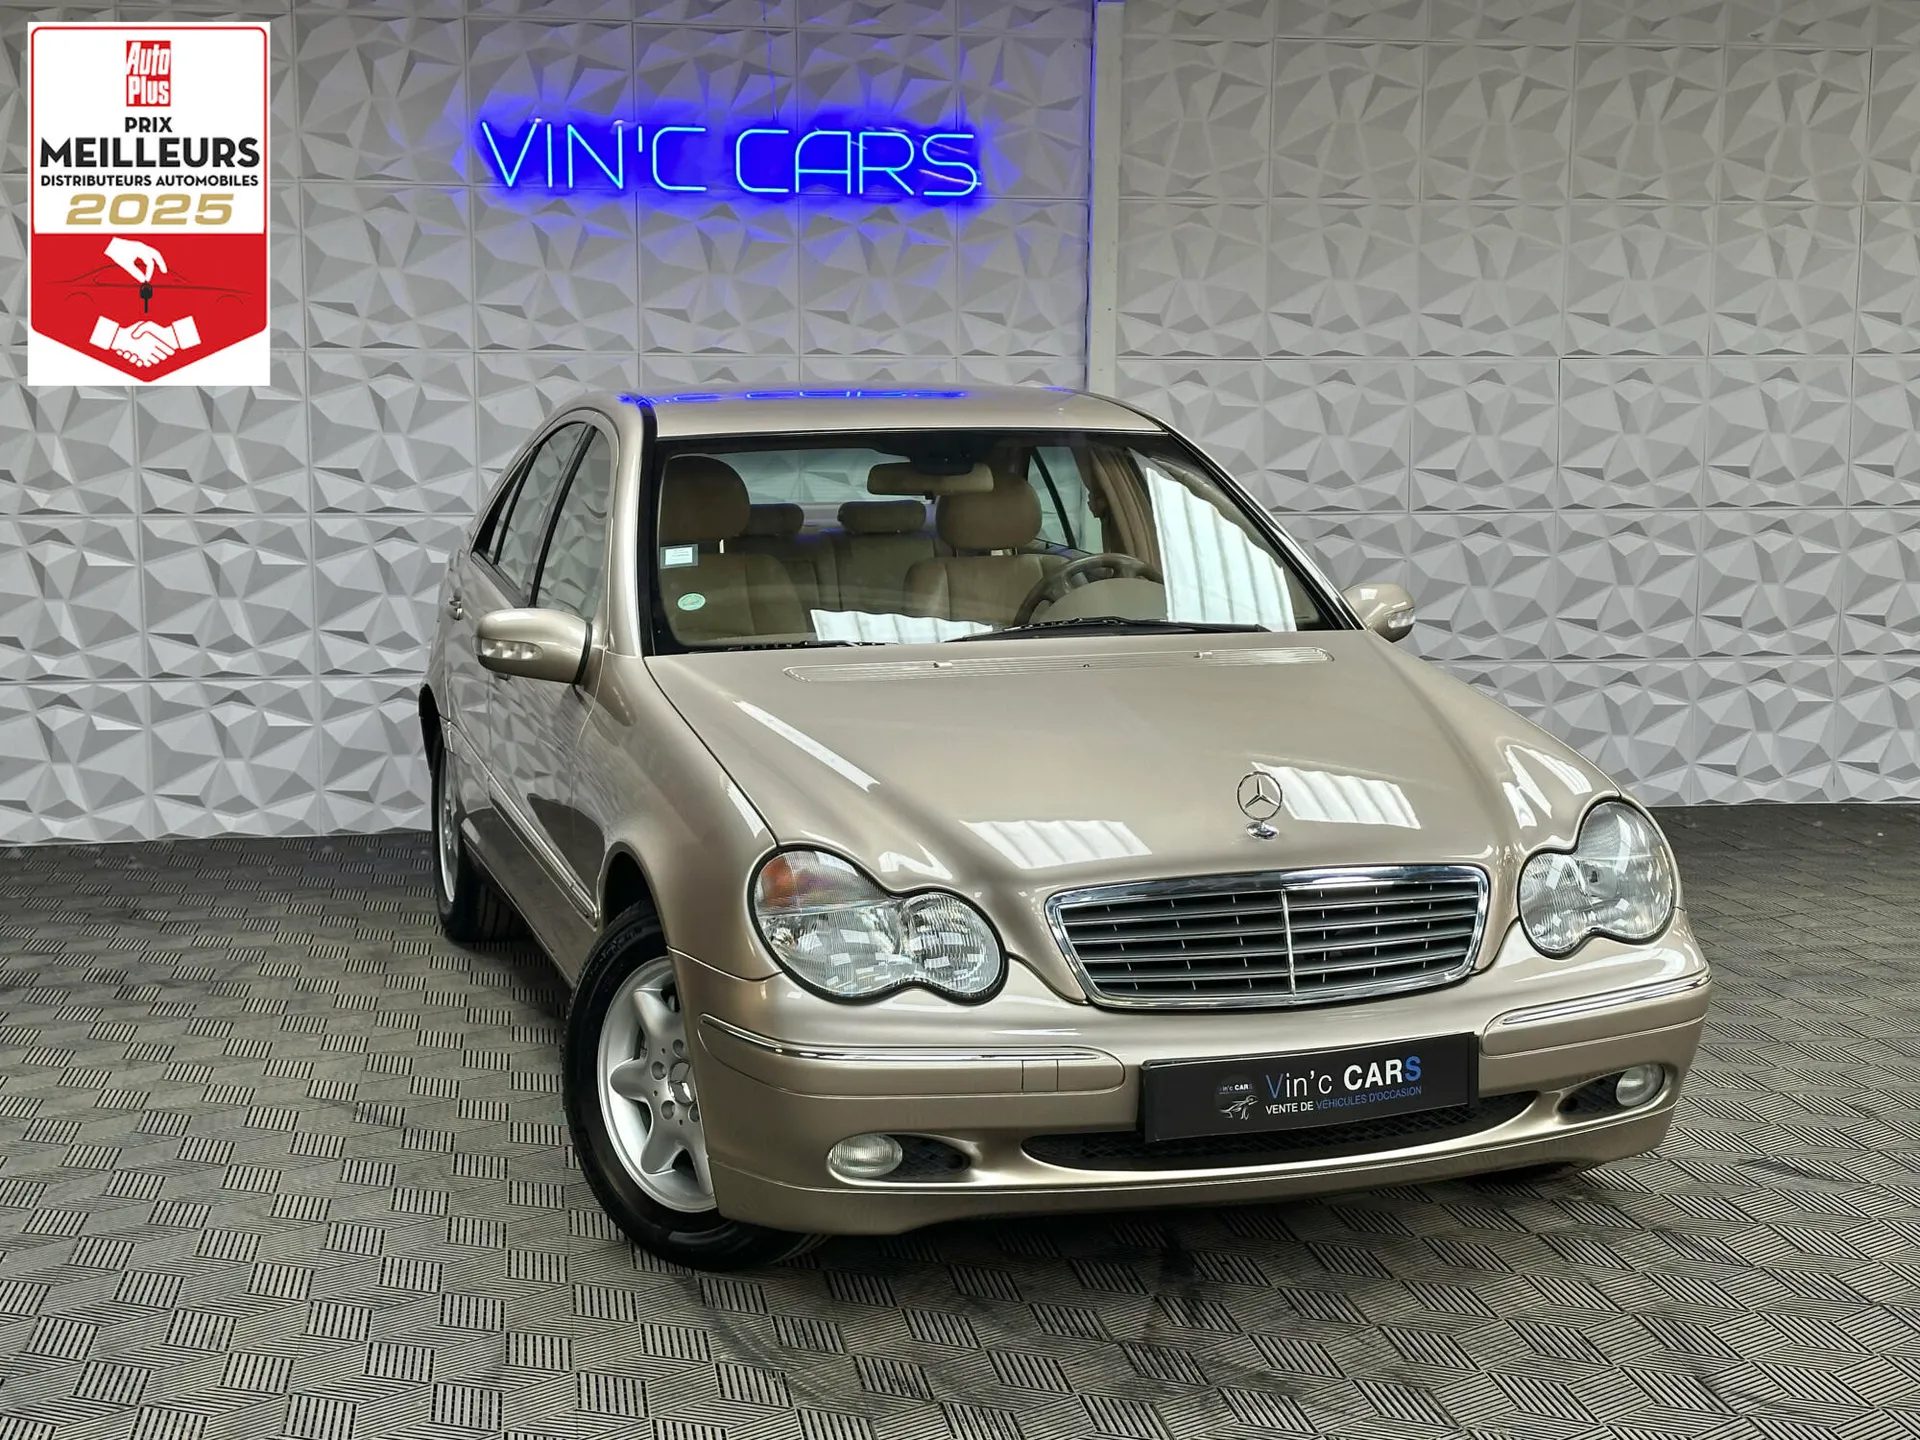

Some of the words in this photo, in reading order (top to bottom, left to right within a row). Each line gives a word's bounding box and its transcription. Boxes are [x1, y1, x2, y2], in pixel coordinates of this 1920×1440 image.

[481, 120, 708, 192] VIN'C
[735, 128, 982, 196] CARS
[1265, 1070, 1333, 1099] Vin'c
[1343, 1055, 1422, 1091] CARS
[1265, 1102, 1298, 1115] VENTE
[1300, 1101, 1314, 1112] DE
[1368, 1086, 1422, 1103] D'OCCASION
